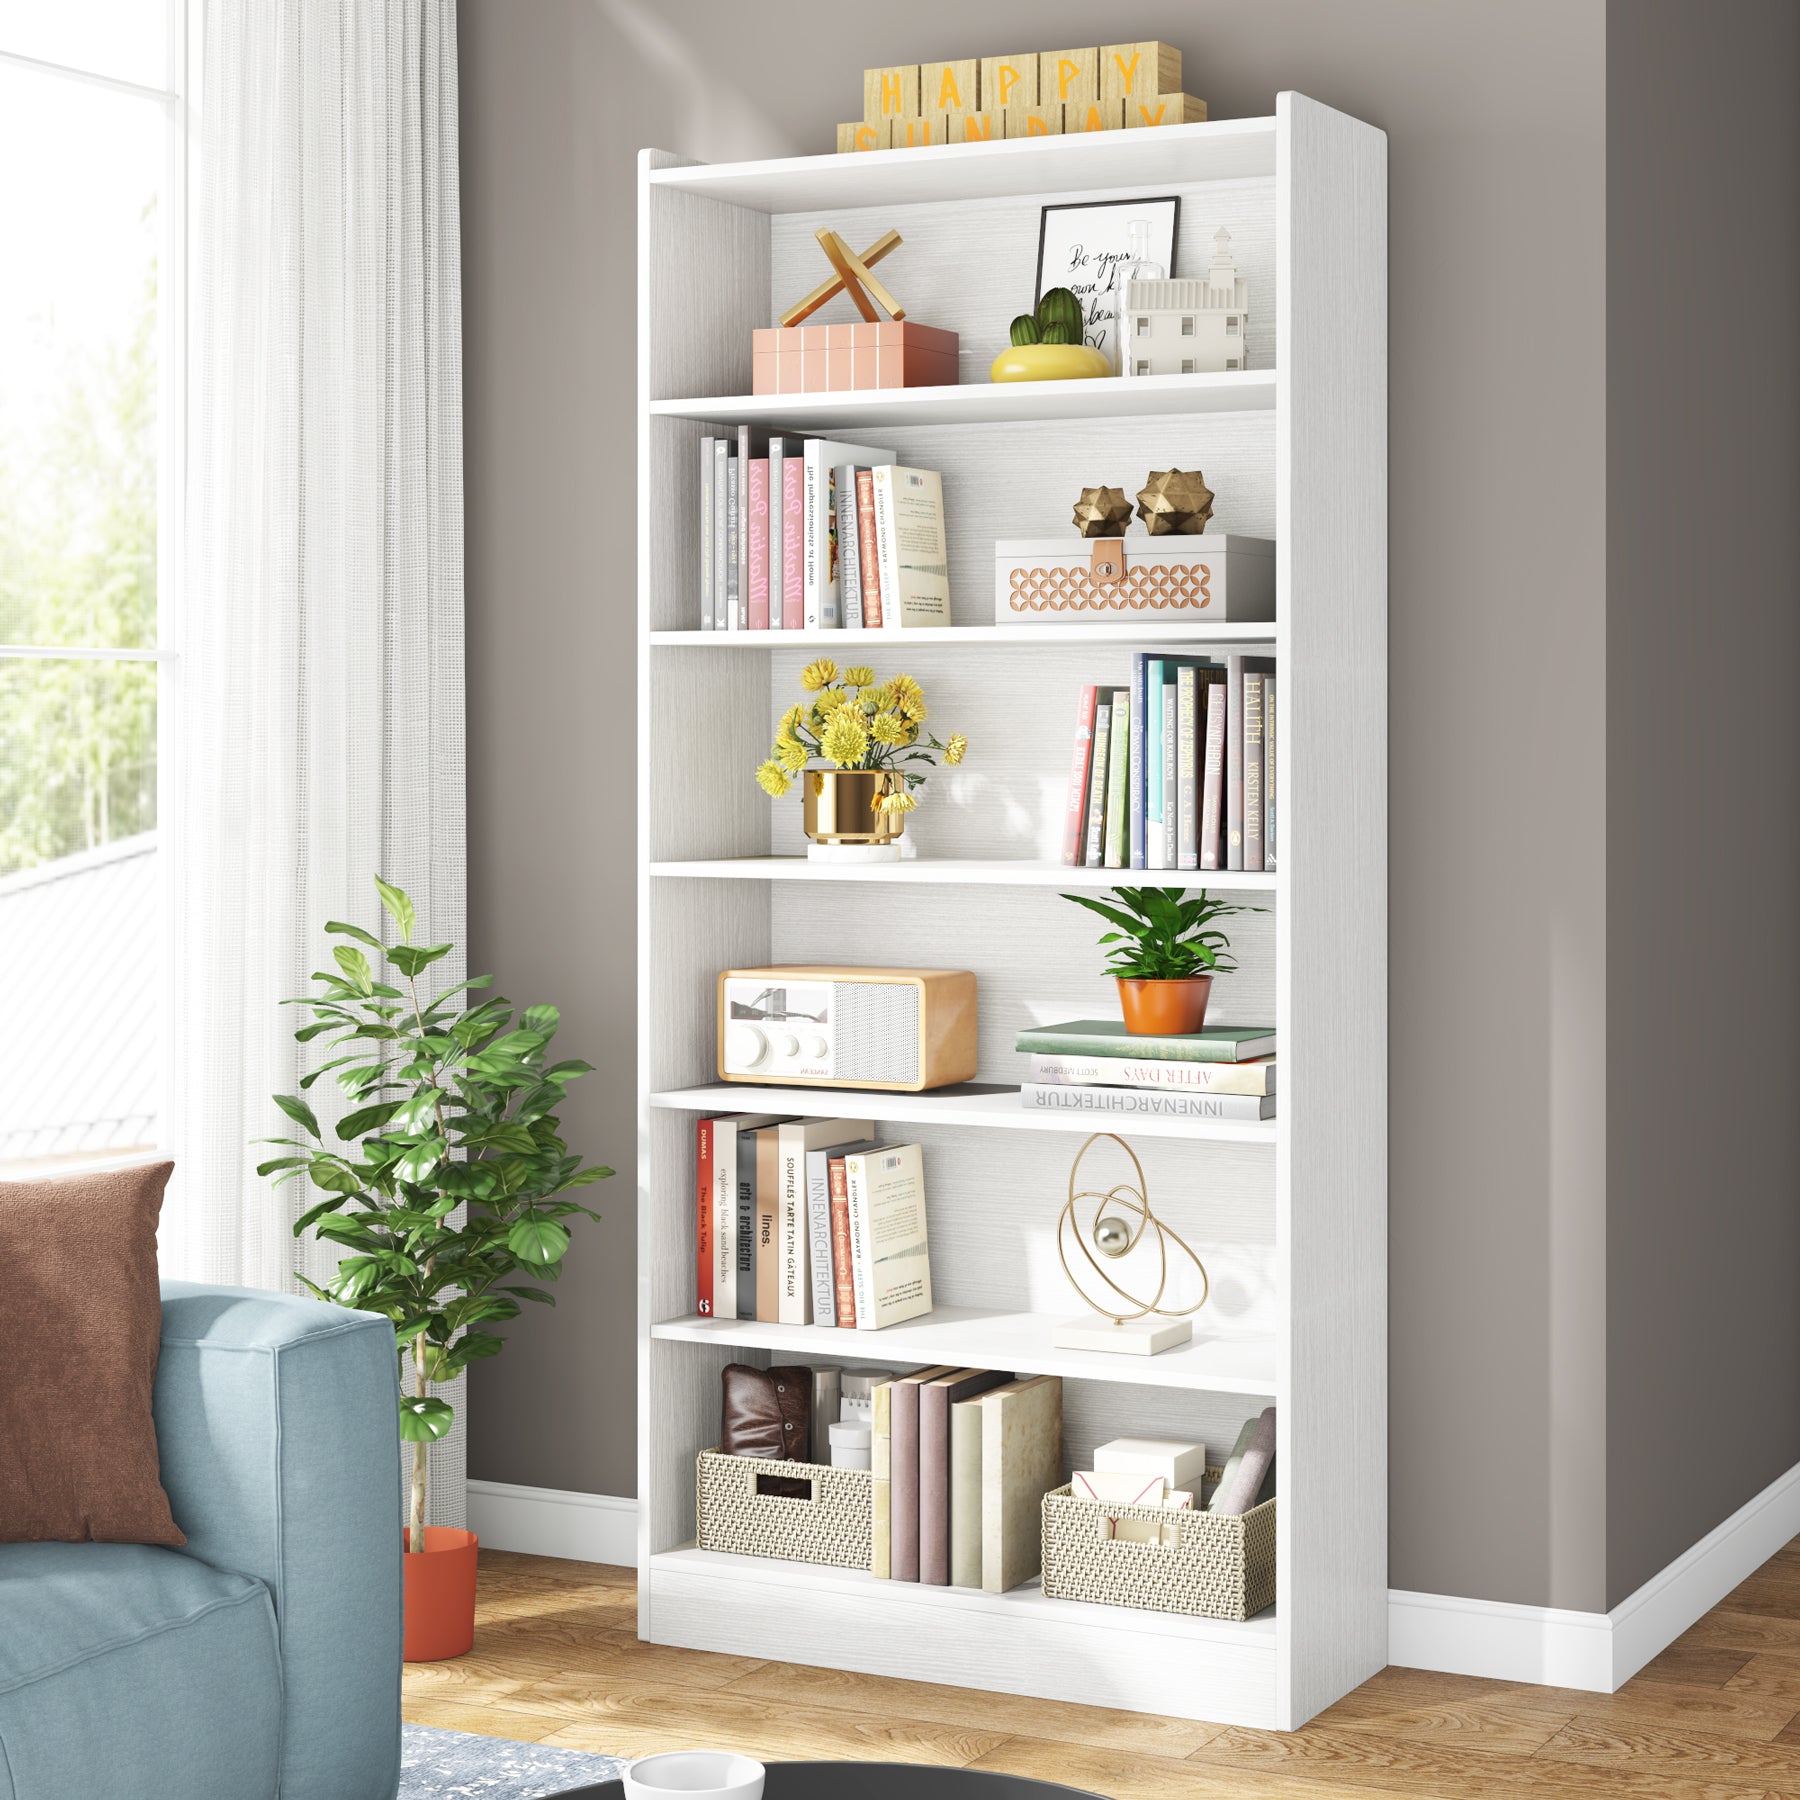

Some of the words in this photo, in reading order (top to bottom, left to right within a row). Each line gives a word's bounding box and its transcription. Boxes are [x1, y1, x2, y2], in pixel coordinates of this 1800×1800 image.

[882, 52, 1140, 114] HAPPY
[1067, 243, 1089, 272] Be
[1070, 283, 1098, 295] own
[877, 488, 885, 525] CHANDLER
[839, 489, 859, 620] INNENARCHITEKTUR
[880, 527, 888, 563] RAYMOND
[1180, 670, 1194, 687] THE
[1166, 698, 1174, 728] WAITING
[1180, 687, 1194, 726] PROPHECY
[1132, 716, 1141, 755] CROWN
[1166, 729, 1174, 743] FOR
[1180, 726, 1194, 739] OF
[1206, 692, 1224, 777] GEOSYNCHRON
[1095, 731, 1107, 767] DUNGEON
[1166, 744, 1174, 761] KARL
[1180, 739, 1194, 779] ZEPHYRUS
[1094, 768, 1105, 778] OF
[1132, 755, 1142, 814] CONSPIRACY
[1166, 762, 1174, 780] ROVE
[1248, 762, 1259, 806] KIRSTEN
[1092, 779, 1104, 804] DEATH
[1247, 810, 1259, 841] KELLY
[1040, 1065, 1075, 1076] MEDBURY
[1075, 1067, 1099, 1076] SCOTT
[1124, 1066, 1161, 1082] DAYS
[1166, 1069, 1212, 1085] AFTER
[1036, 1090, 1222, 1117] INNENARCHITEKTUR
[718, 1168, 729, 1207] exploring
[740, 1182, 750, 1201] arts
[786, 1157, 795, 1199] SOUFFLÉS
[851, 1179, 859, 1218] CHANDLER
[720, 1208, 729, 1230] black
[761, 1214, 772, 1247] lines.
[786, 1201, 795, 1229] TARTE
[720, 1231, 729, 1251] sand
[740, 1215, 752, 1272] architecture
[787, 1229, 795, 1256] TATIN
[811, 1177, 832, 1316] INNENARCHITEKTUR
[853, 1220, 861, 1259] RAYMOND
[720, 1251, 729, 1283] beaches
[786, 1257, 796, 1298] GÂTEAUX
